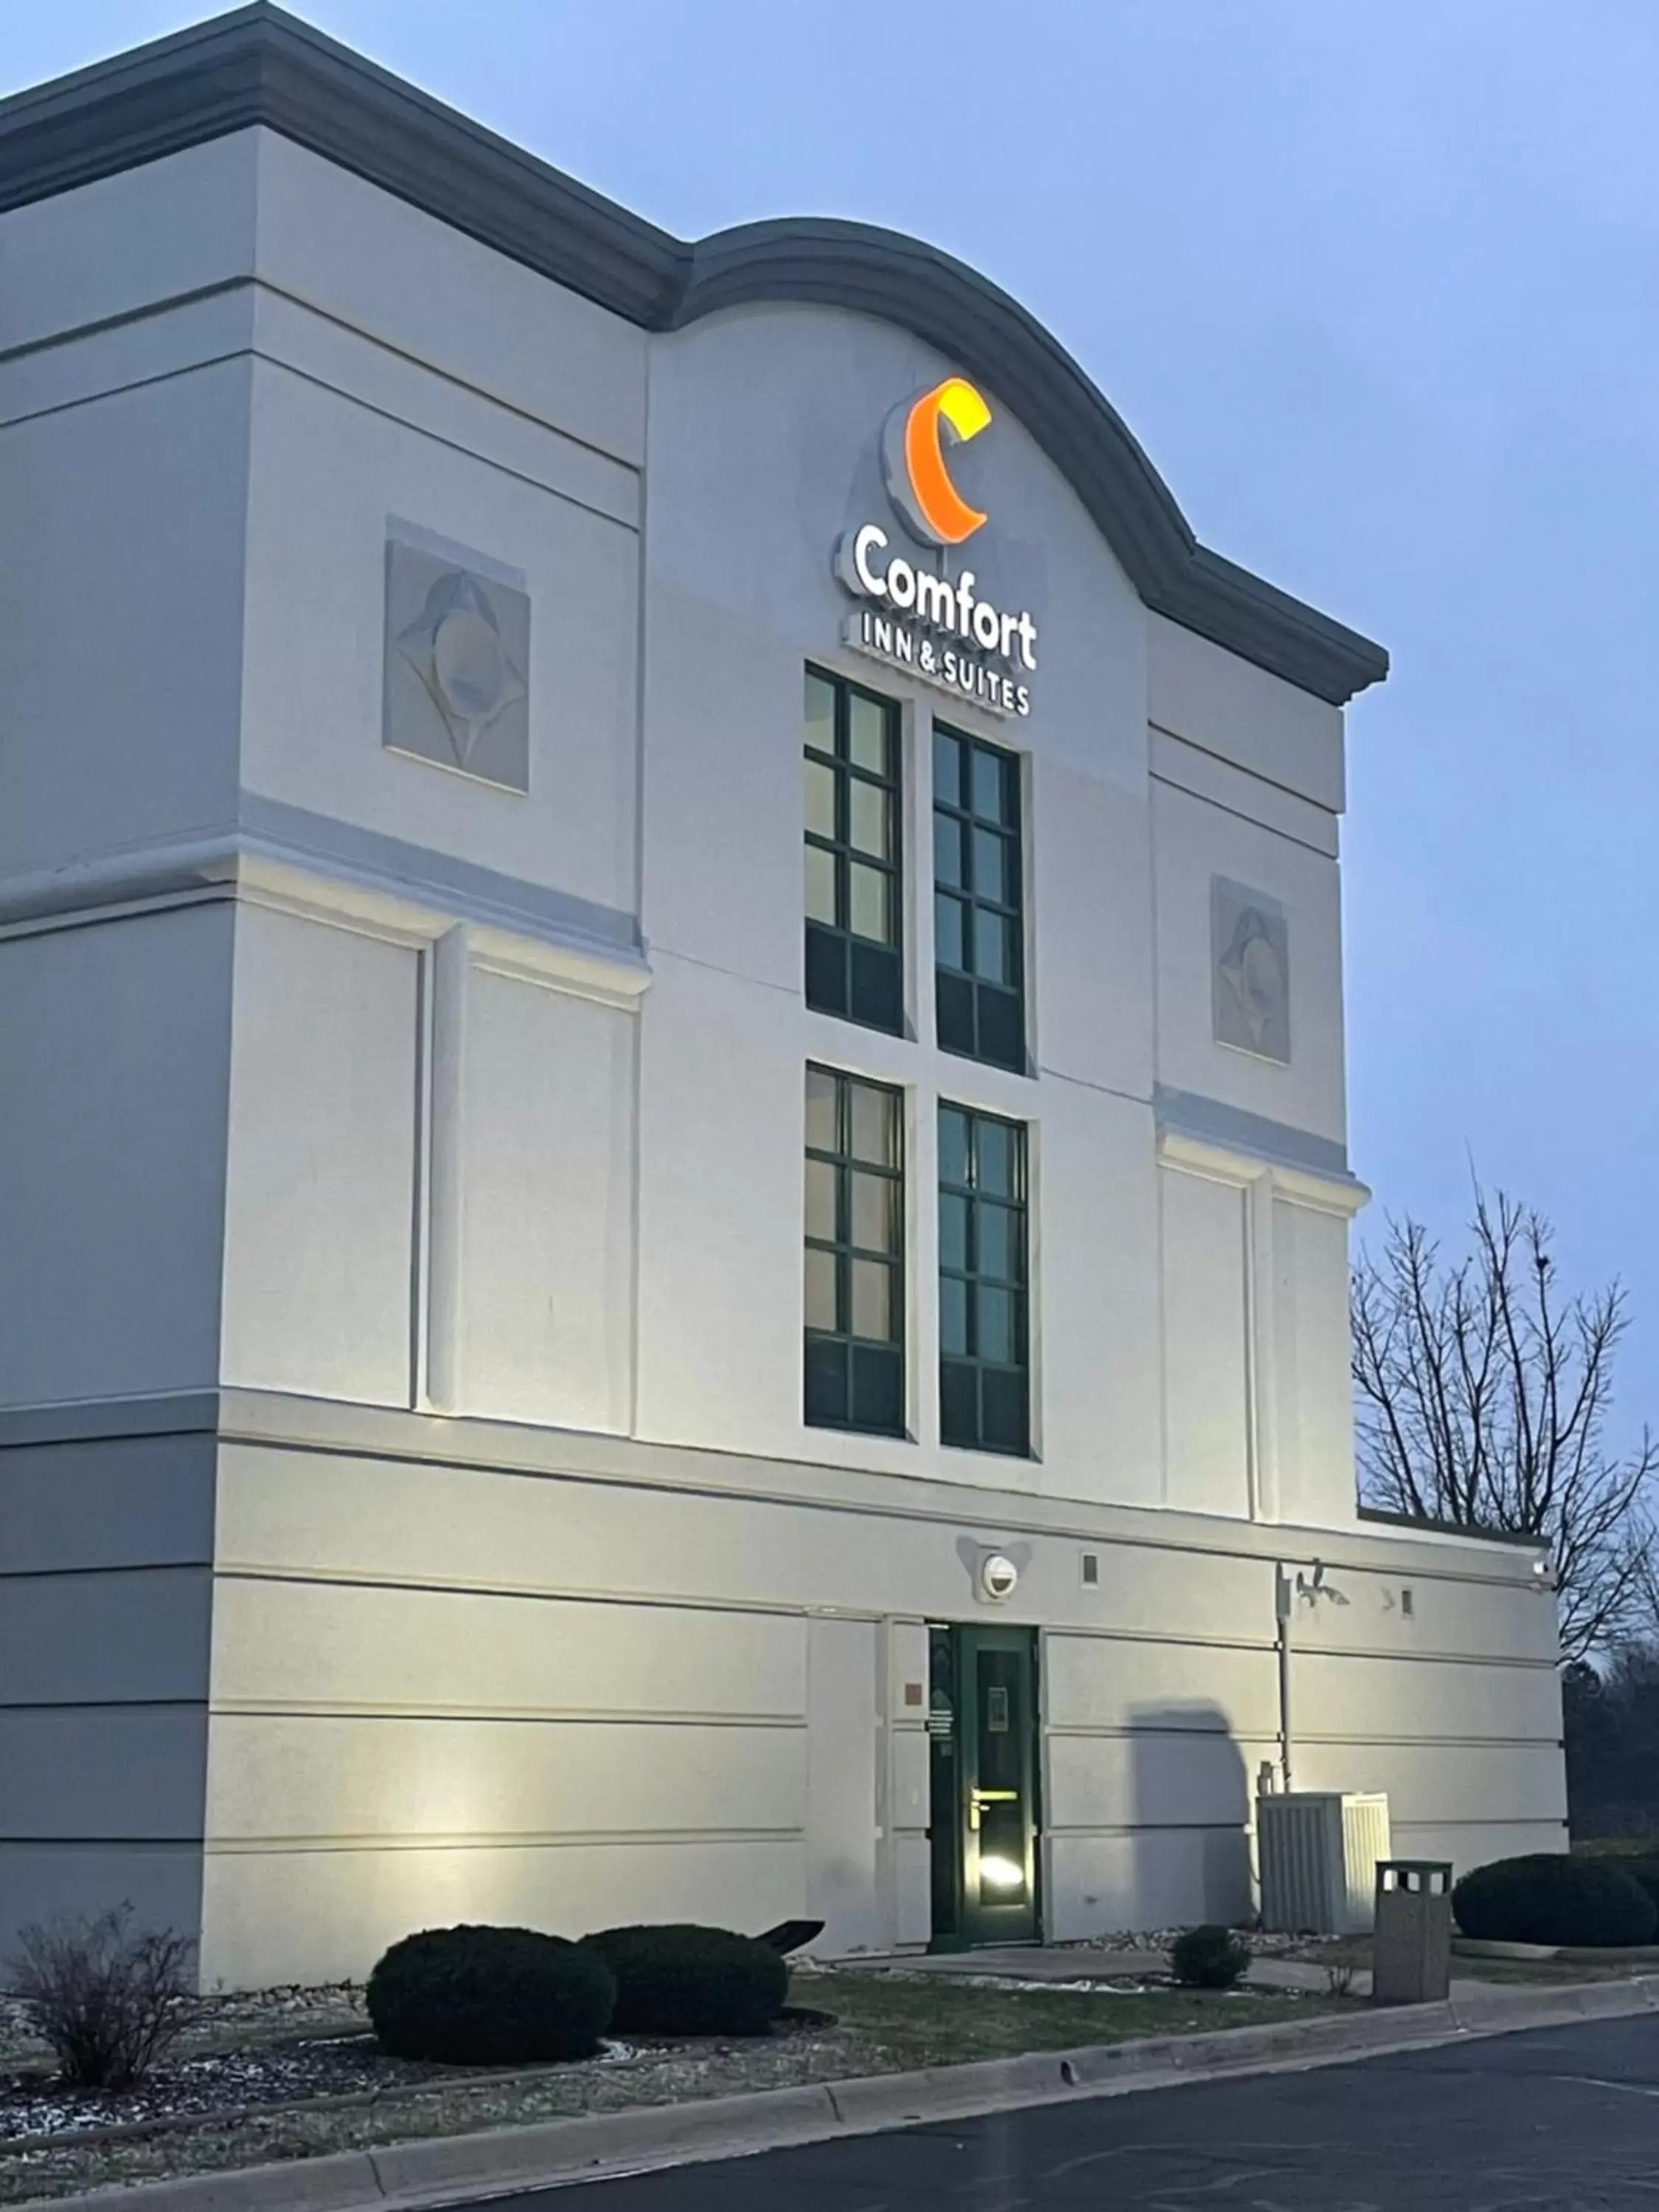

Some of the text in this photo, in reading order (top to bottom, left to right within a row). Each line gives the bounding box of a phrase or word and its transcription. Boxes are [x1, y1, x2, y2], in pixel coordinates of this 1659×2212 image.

[855, 524, 1037, 670] Comfort
[861, 611, 1030, 717] INN & SUITES
